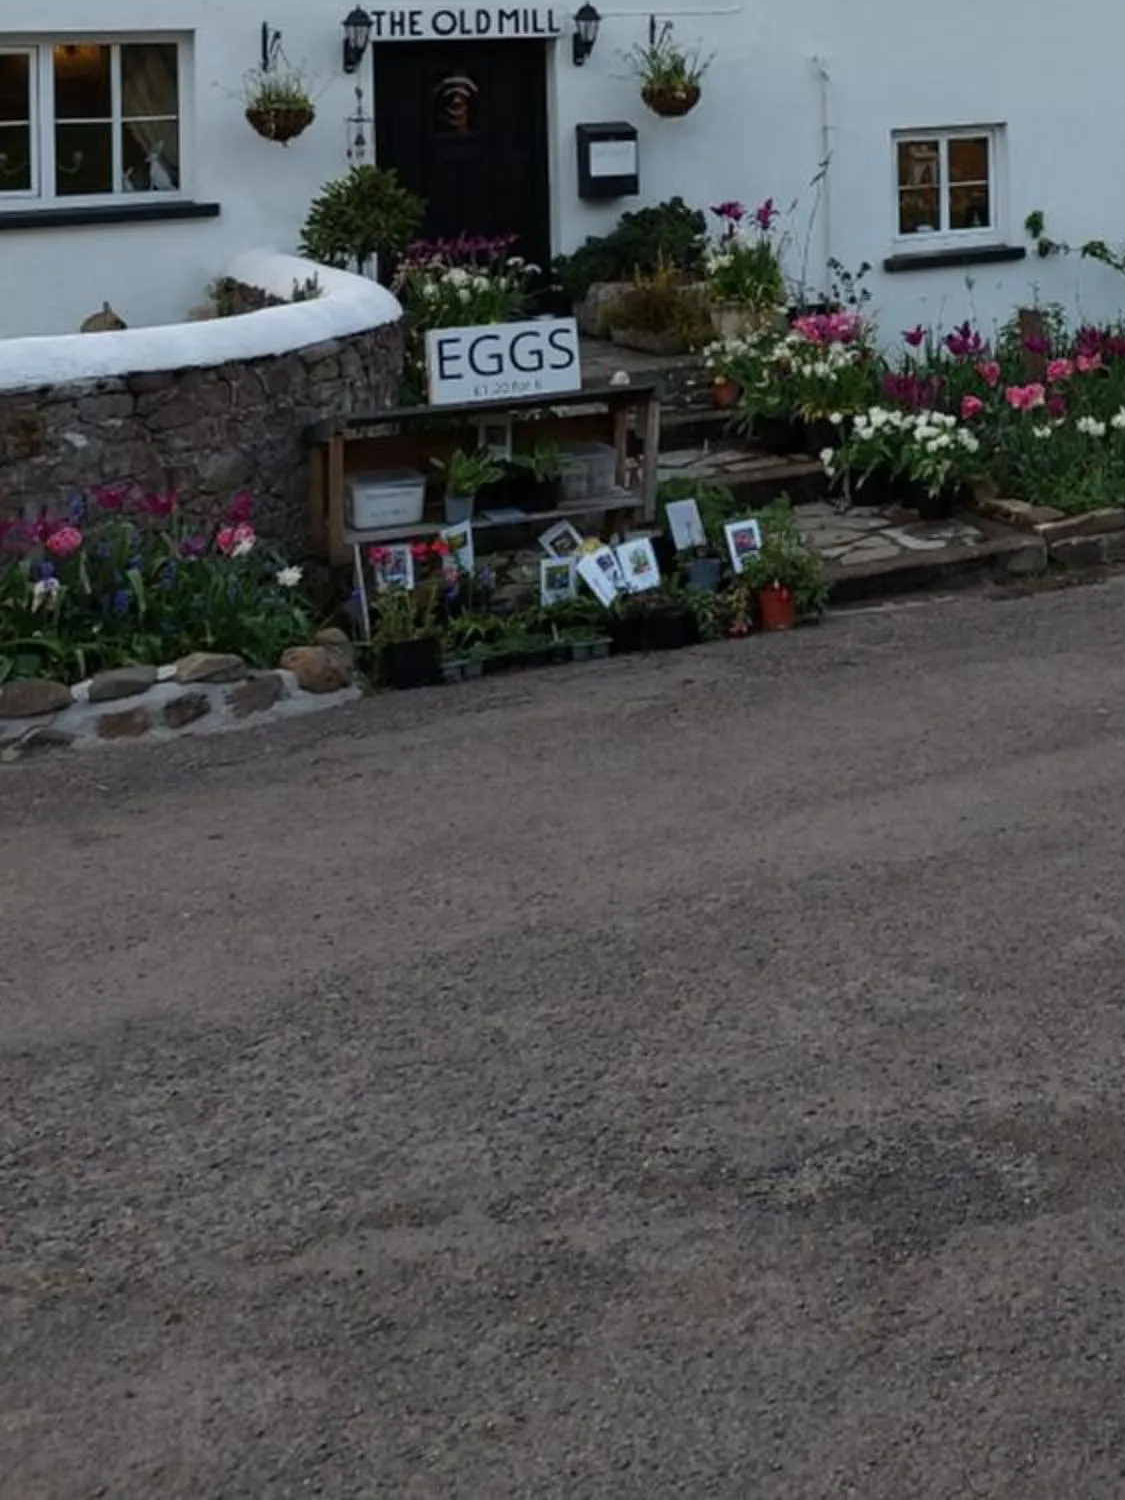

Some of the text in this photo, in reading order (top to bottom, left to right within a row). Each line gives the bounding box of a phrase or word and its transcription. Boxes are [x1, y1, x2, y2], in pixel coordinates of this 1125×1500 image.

[371, 8, 561, 36] THE OLD MILL
[438, 328, 575, 380] EGGS
